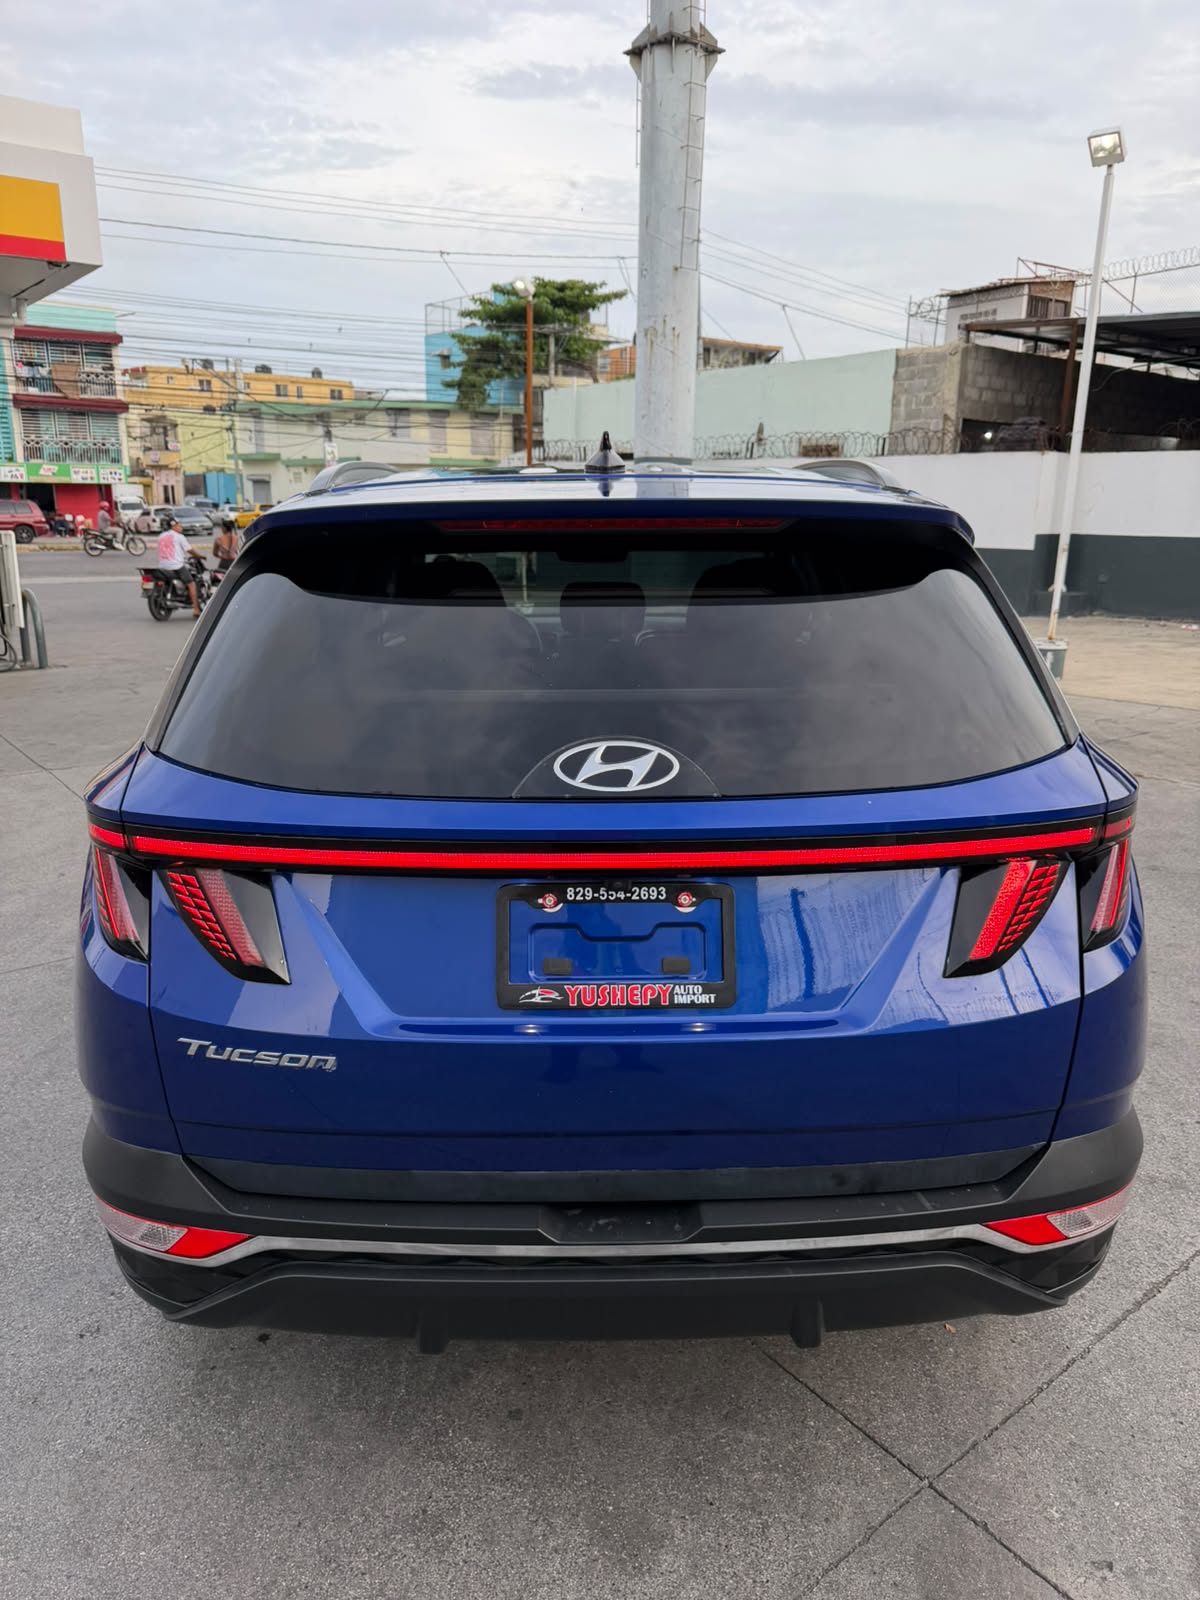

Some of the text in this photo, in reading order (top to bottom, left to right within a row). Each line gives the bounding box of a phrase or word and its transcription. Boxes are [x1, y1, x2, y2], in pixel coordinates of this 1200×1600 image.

[673, 984, 703, 995] AUTO
[564, 984, 674, 1007] YUSHEPY
[674, 994, 717, 1004] IMPORT
